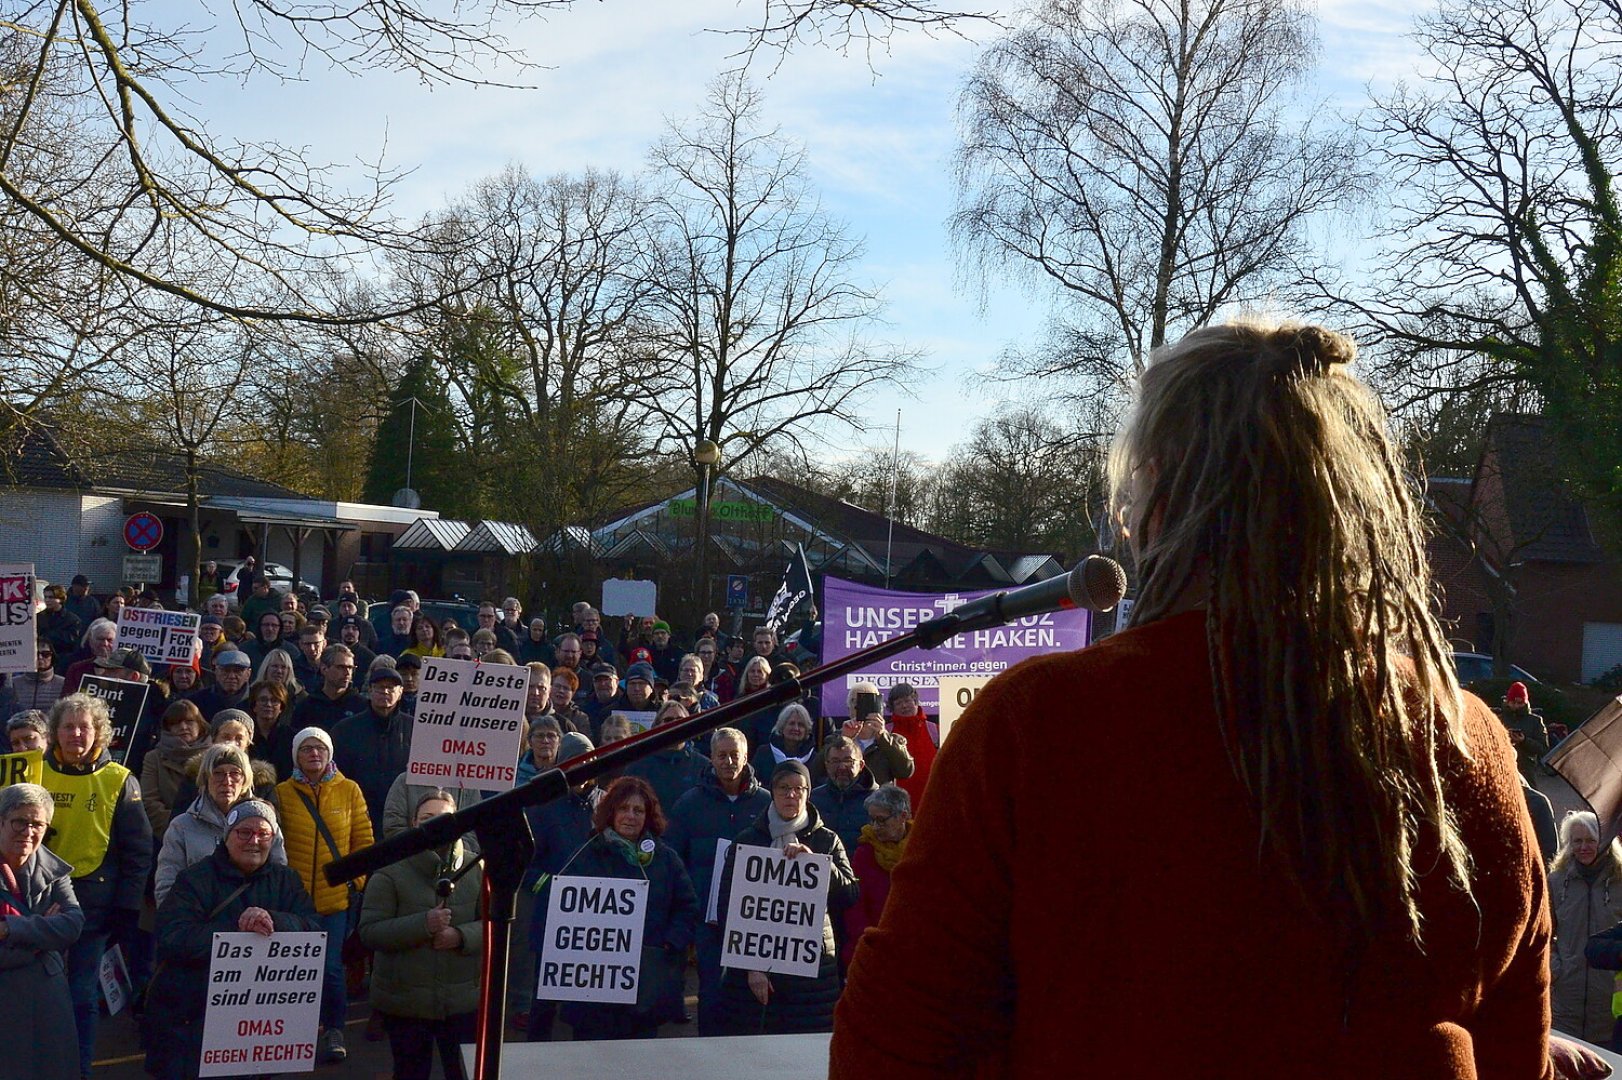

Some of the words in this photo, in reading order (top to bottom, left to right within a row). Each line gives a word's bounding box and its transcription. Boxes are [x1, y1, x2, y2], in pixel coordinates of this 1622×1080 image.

[1, 580, 23, 600] K
[123, 609, 198, 627] OSTFRIESEN
[120, 626, 159, 638] gegen
[169, 633, 194, 647] FCK
[846, 630, 892, 649] HAT
[974, 628, 1061, 649] HAKEN.
[168, 646, 190, 658] AfD
[969, 660, 1008, 672] gegen
[424, 666, 459, 683] Das
[472, 670, 525, 690] Beste
[86, 683, 124, 701] Bunt
[420, 691, 447, 705] am
[459, 691, 520, 711] Norden
[418, 709, 456, 726] sind
[459, 716, 518, 732] unsere
[442, 739, 487, 756] OMAS
[410, 762, 452, 777] GEGEN
[456, 763, 515, 781] RECHTS
[51, 793, 76, 802] NESTY
[745, 855, 820, 890] OMAS
[560, 886, 636, 915] OMAS
[740, 895, 816, 927] GEGEN
[555, 926, 632, 953] GEGEN
[727, 930, 818, 964] RECHTS
[216, 941, 253, 959] Das
[267, 941, 322, 958] Beste
[212, 969, 242, 983] am
[254, 965, 318, 982] Norden
[542, 961, 636, 990] RECHTS
[211, 988, 252, 1006] sind
[255, 991, 317, 1005] unsere
[237, 1019, 284, 1037] OMAS
[204, 1049, 248, 1064] GEGEN
[252, 1043, 314, 1062] RECHTS
